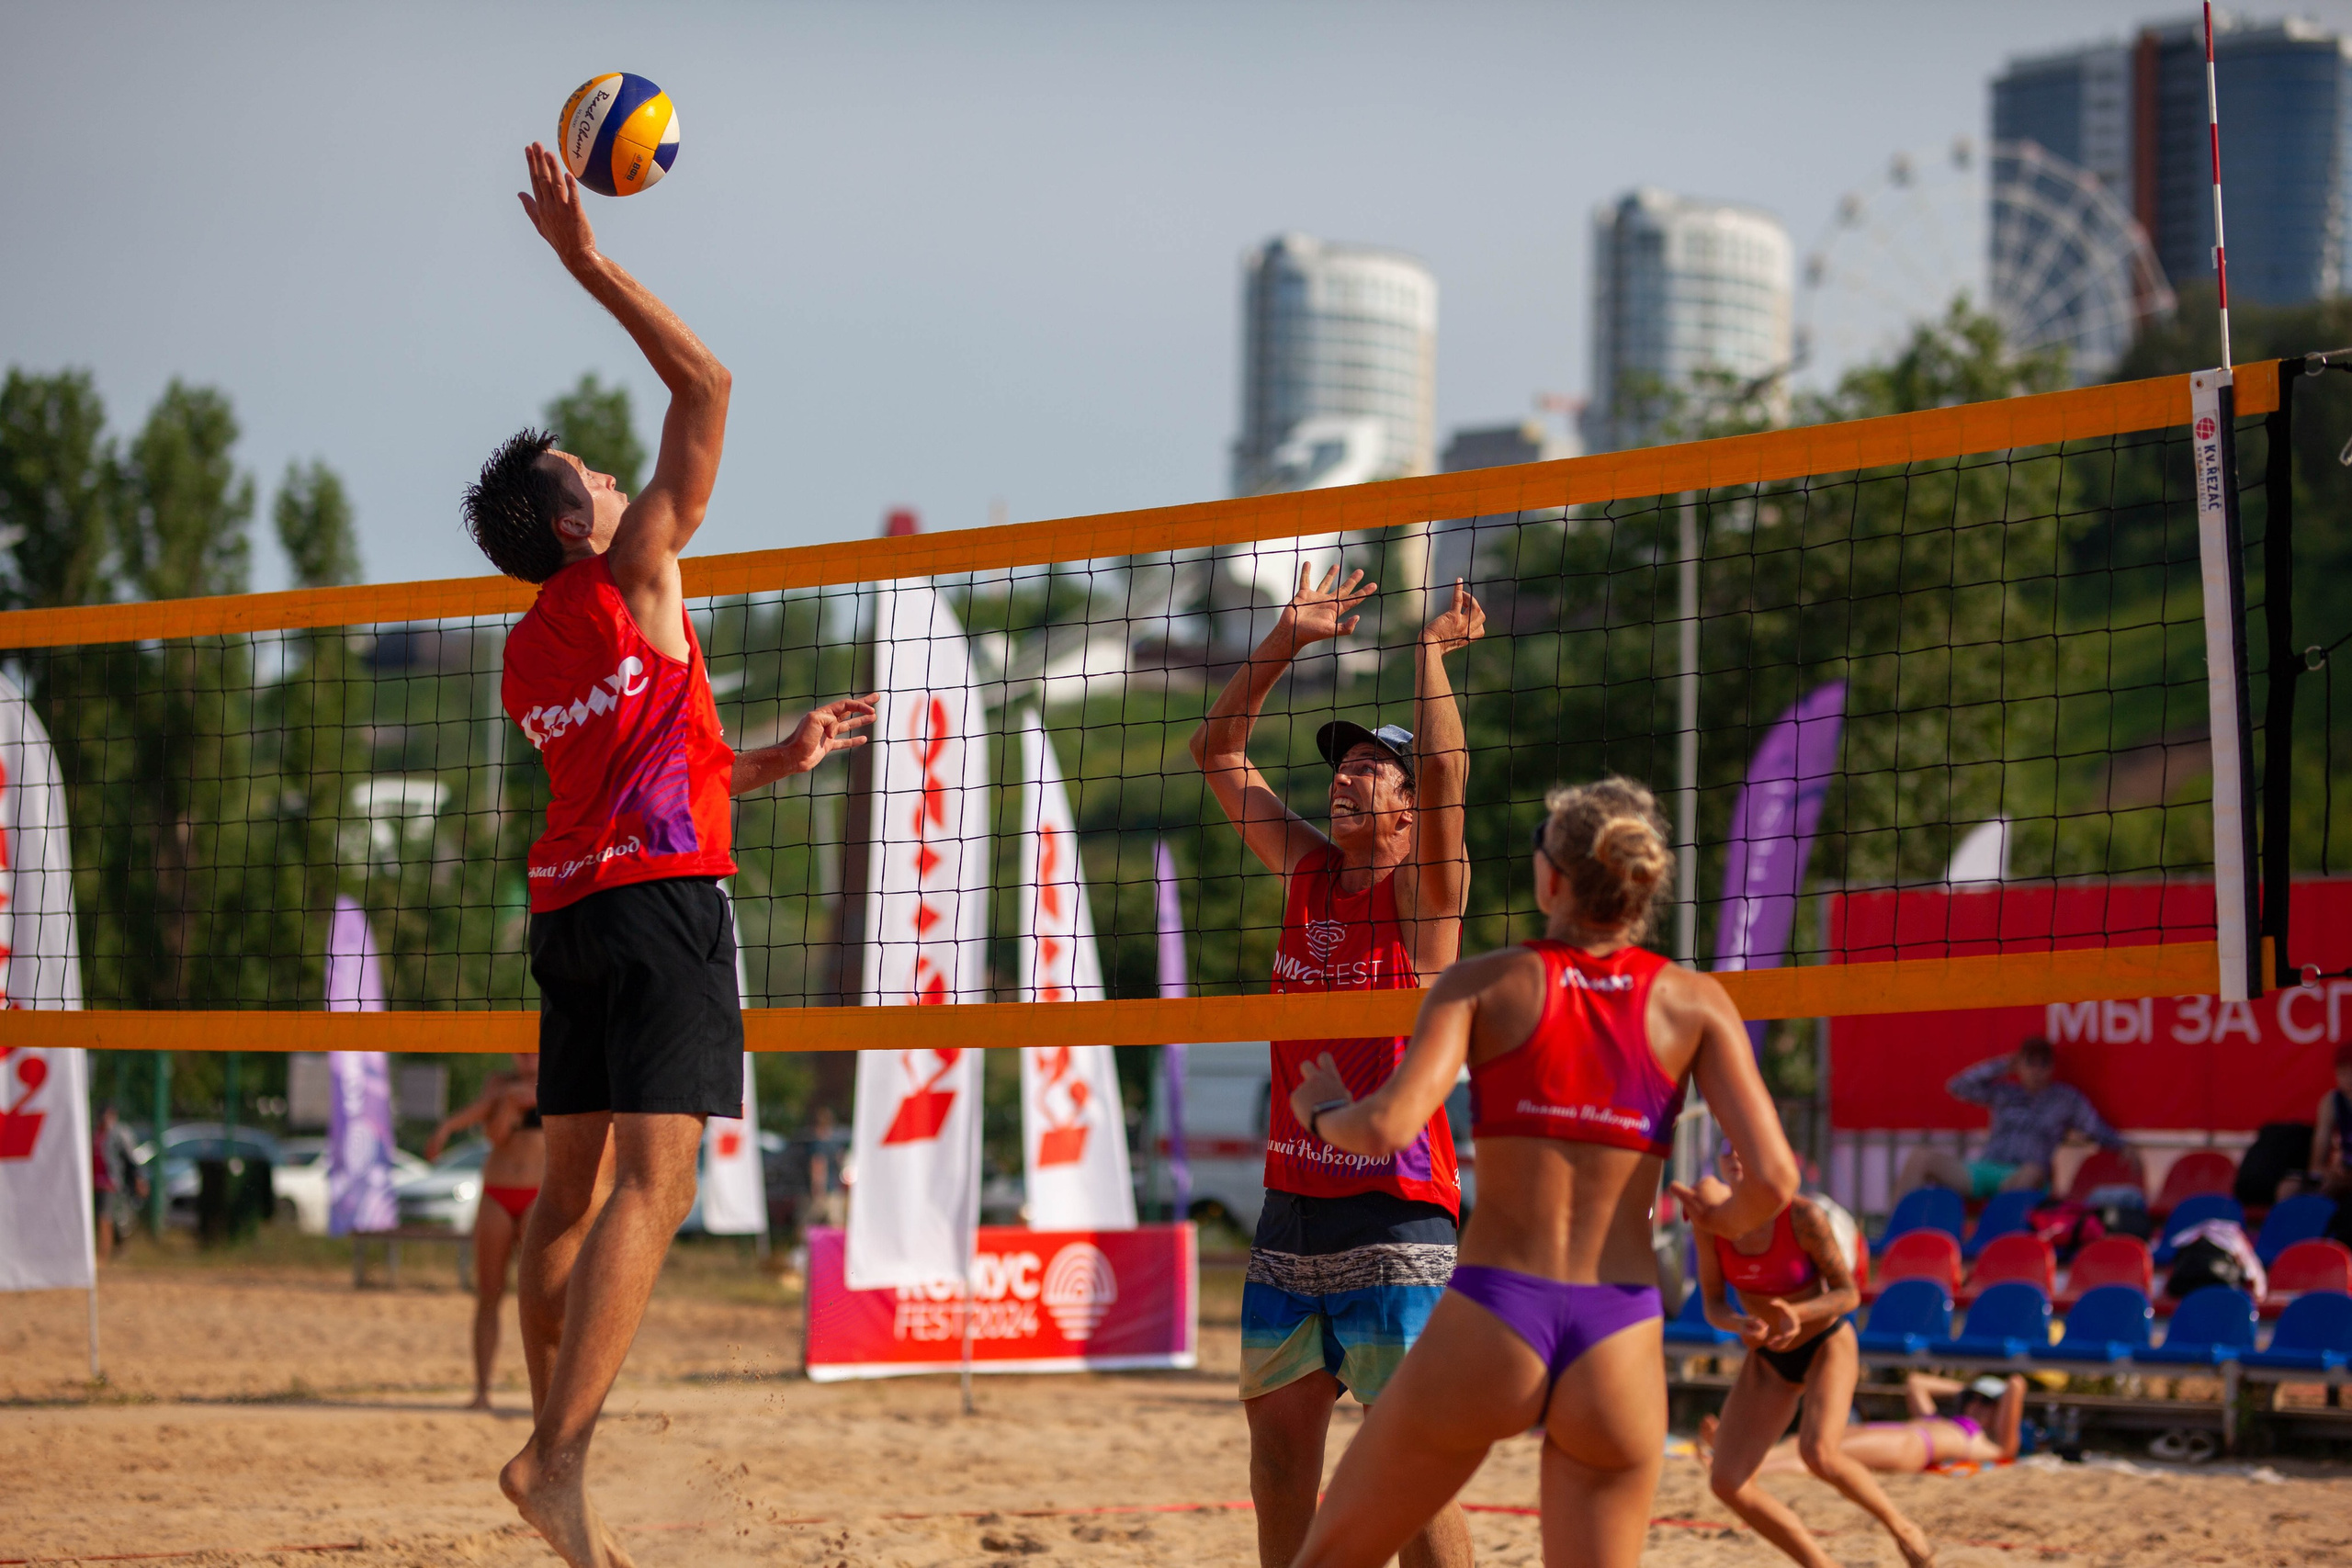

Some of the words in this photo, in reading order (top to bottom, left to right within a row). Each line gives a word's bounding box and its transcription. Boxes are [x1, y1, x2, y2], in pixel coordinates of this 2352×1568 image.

[584, 89, 610, 121] Beach
[571, 120, 591, 159] Champ
[2045, 995, 2154, 1045] МЫ
[2170, 994, 2262, 1045] ЗА
